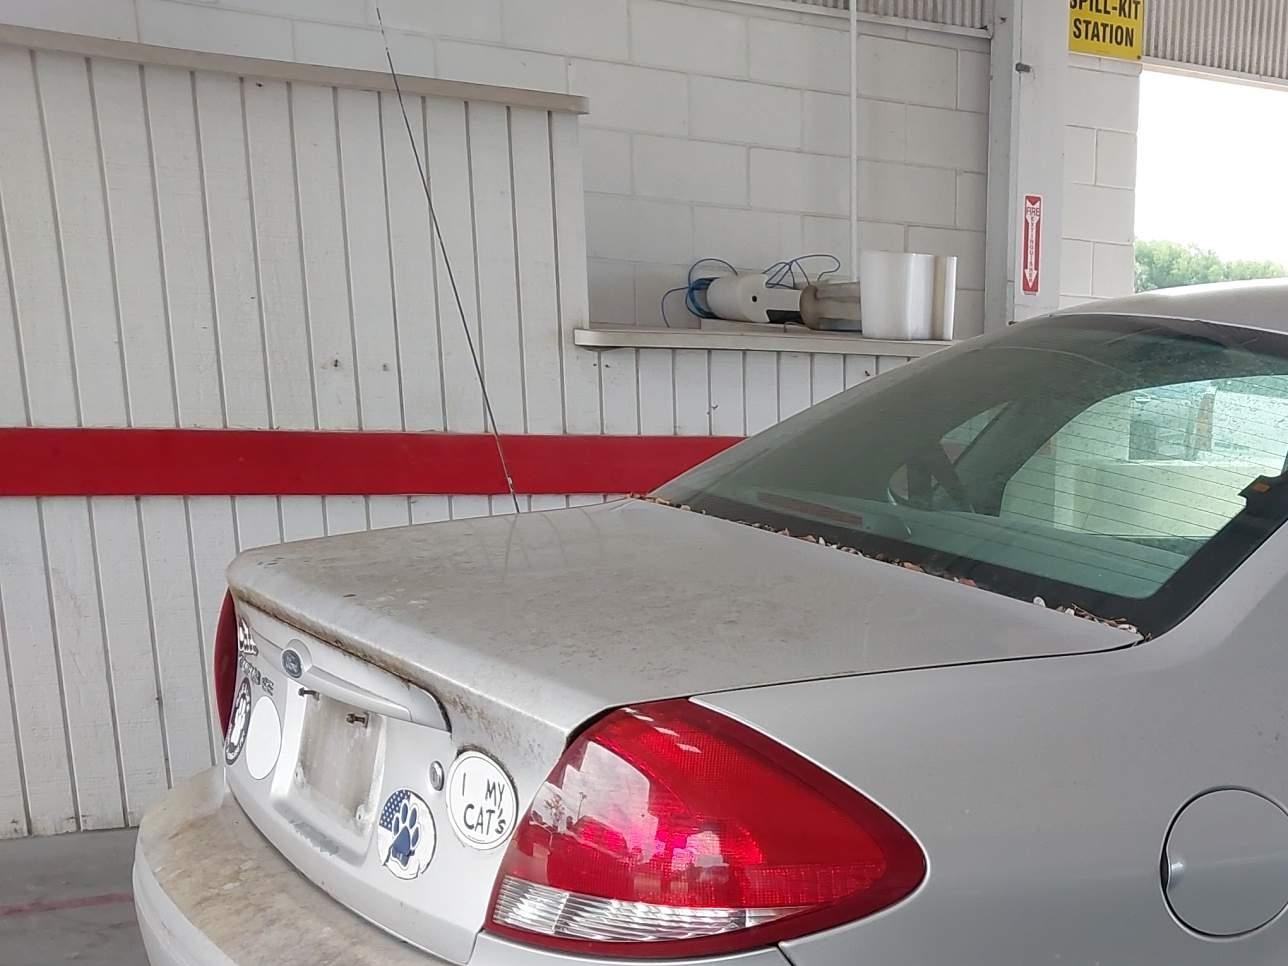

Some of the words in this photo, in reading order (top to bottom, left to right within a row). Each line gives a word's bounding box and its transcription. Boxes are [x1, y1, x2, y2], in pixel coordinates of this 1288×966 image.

[1073, 17, 1134, 48] STATION
[462, 772, 467, 797] I
[485, 779, 505, 810] MY
[463, 803, 506, 835] CAT'S
